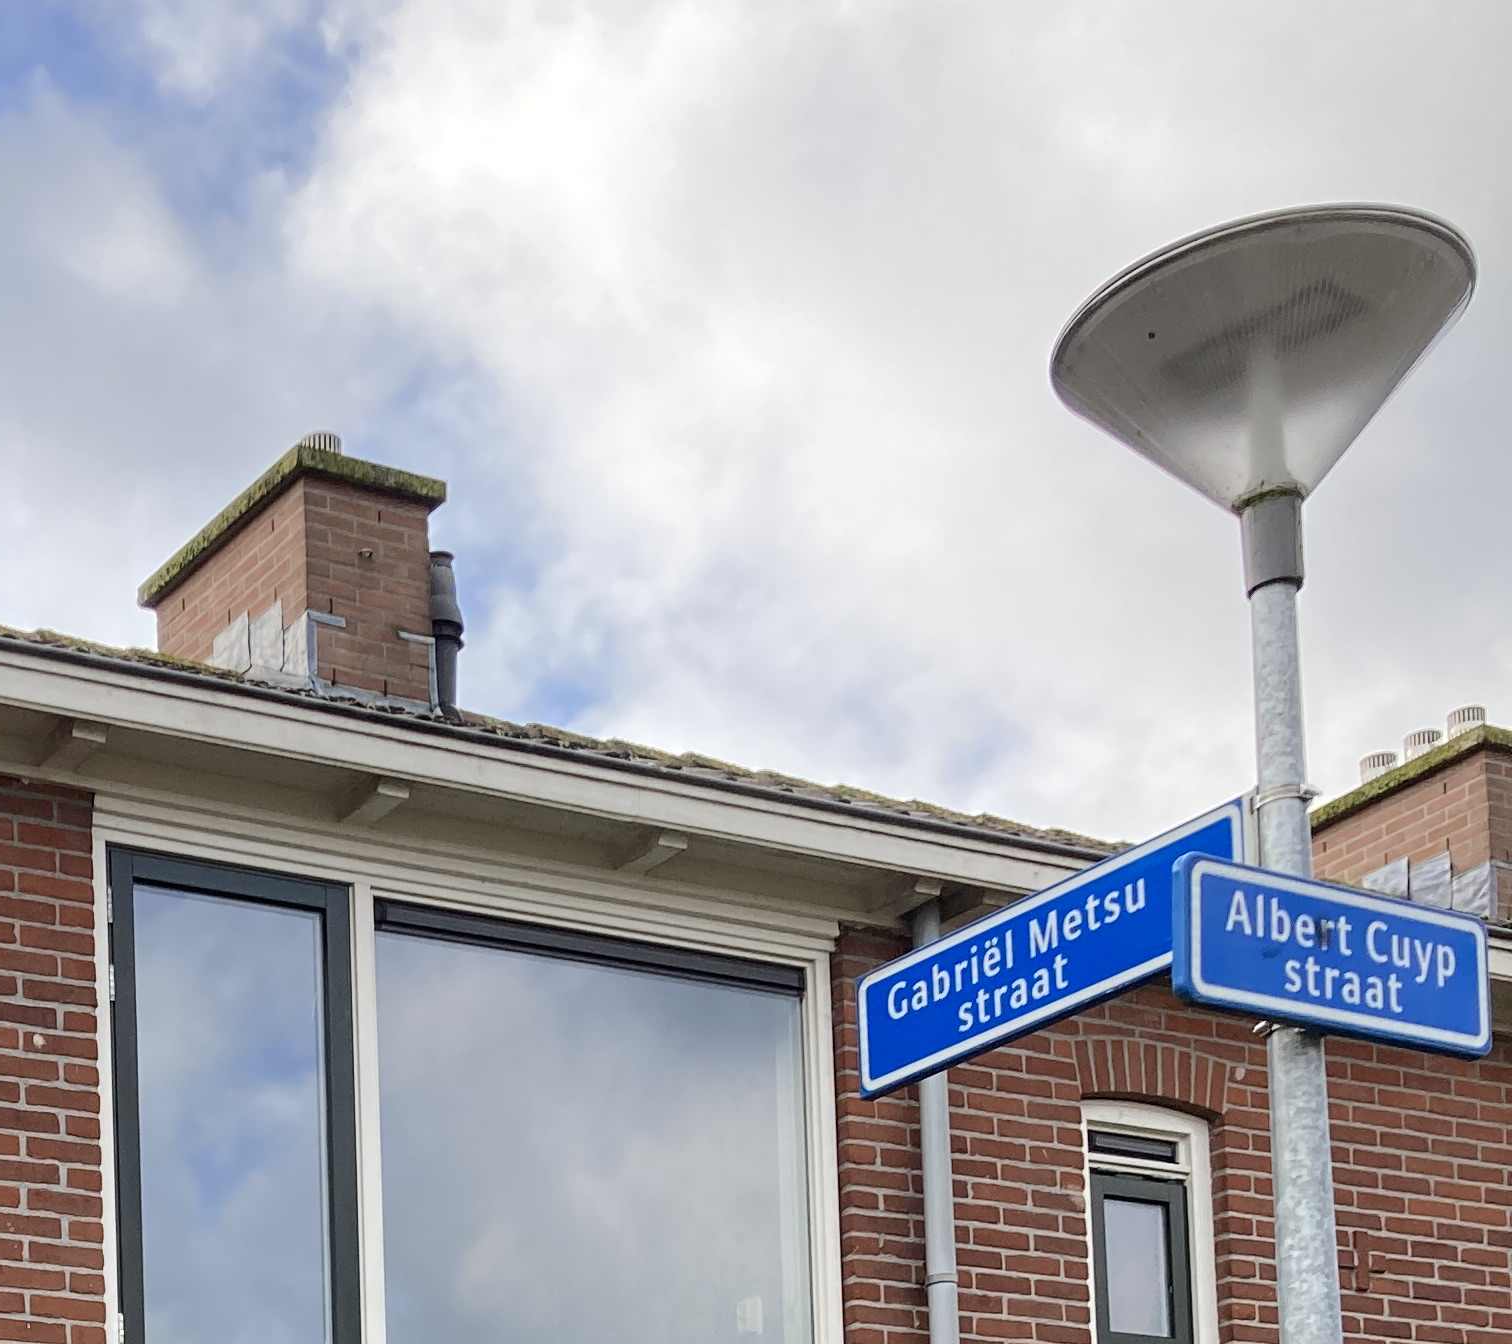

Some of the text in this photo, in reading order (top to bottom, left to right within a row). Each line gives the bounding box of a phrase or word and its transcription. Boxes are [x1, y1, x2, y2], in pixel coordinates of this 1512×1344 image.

[887, 878, 1146, 1020] Gabriël Metsu
[1226, 890, 1456, 988] Albert Cuyp
[958, 954, 1068, 1032] straat
[1285, 959, 1403, 1013] straat
